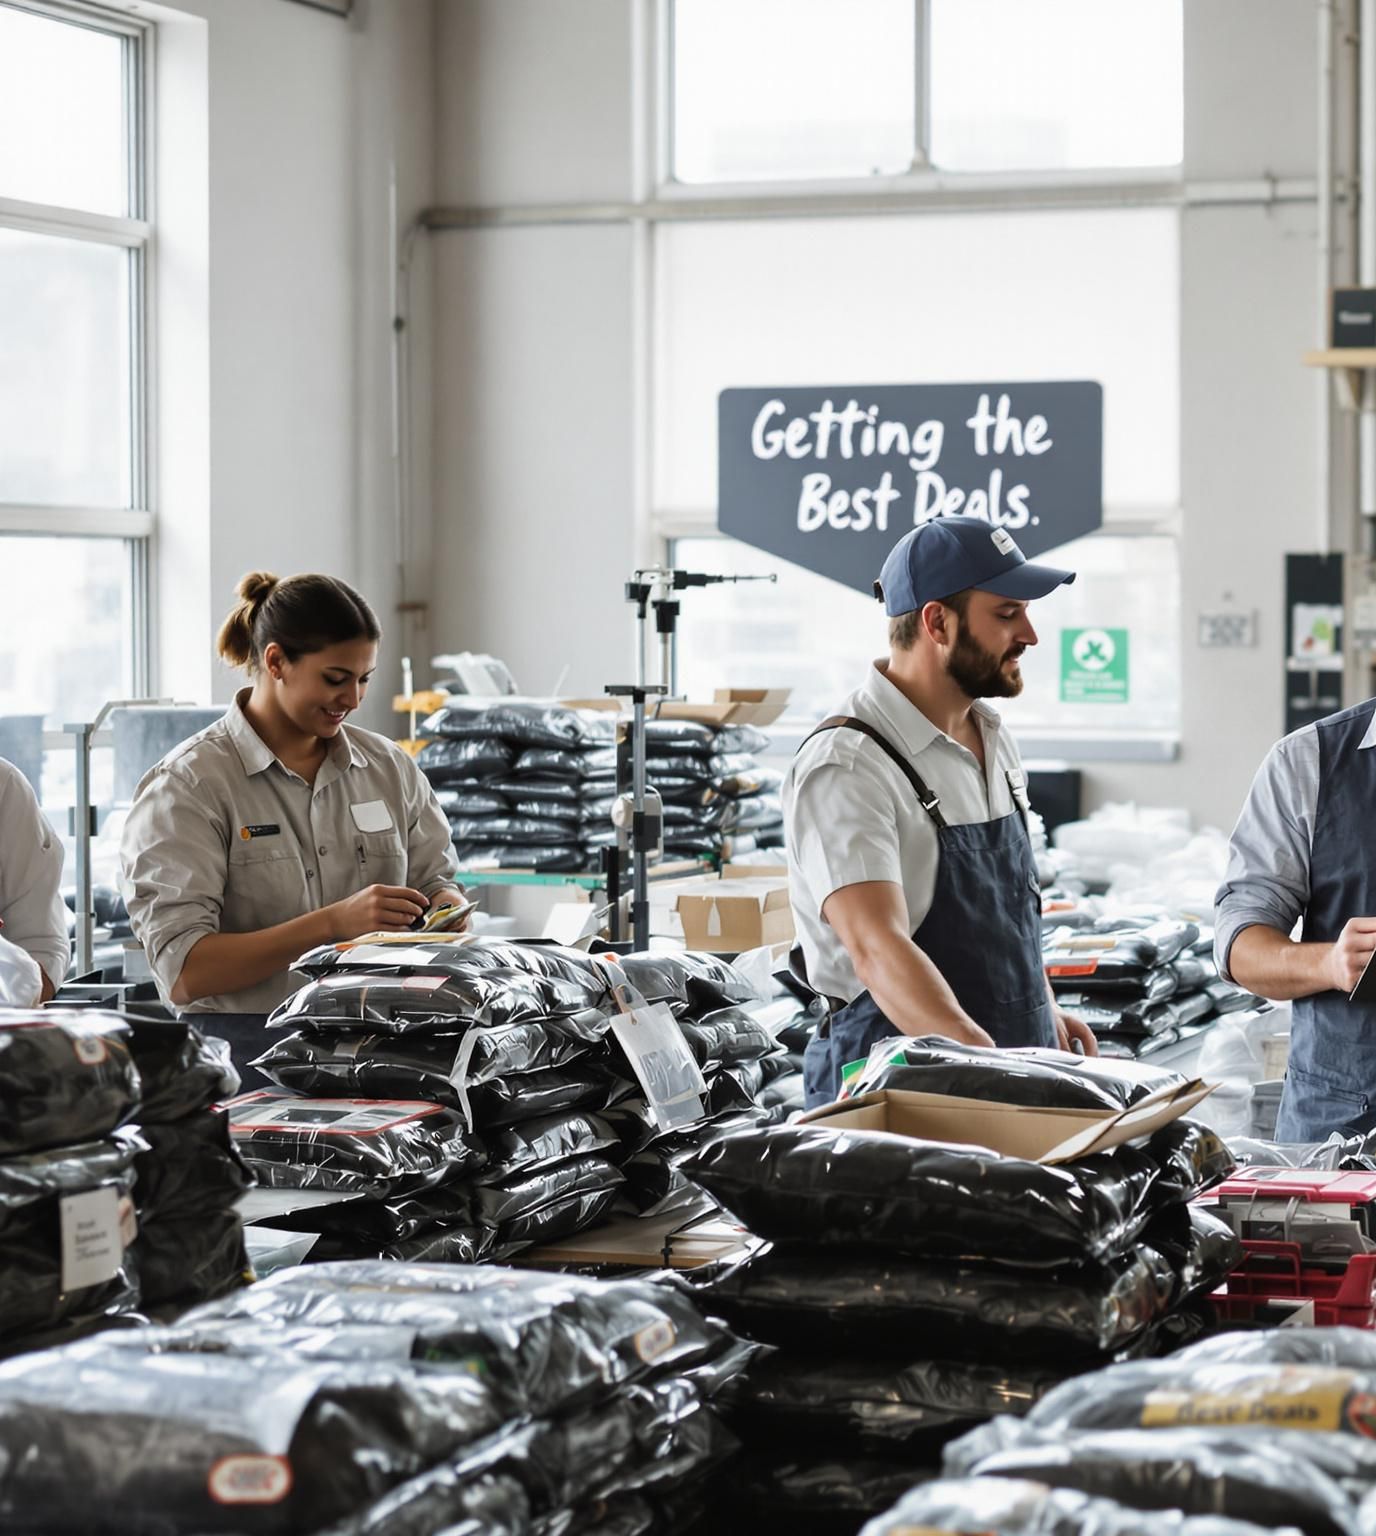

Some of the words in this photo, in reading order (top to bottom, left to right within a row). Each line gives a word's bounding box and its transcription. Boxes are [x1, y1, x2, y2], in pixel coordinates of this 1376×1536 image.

[752, 400, 945, 471] Getting
[966, 393, 1053, 457] the
[797, 471, 901, 532] Best
[1250, 1401, 1320, 1422] Deals
